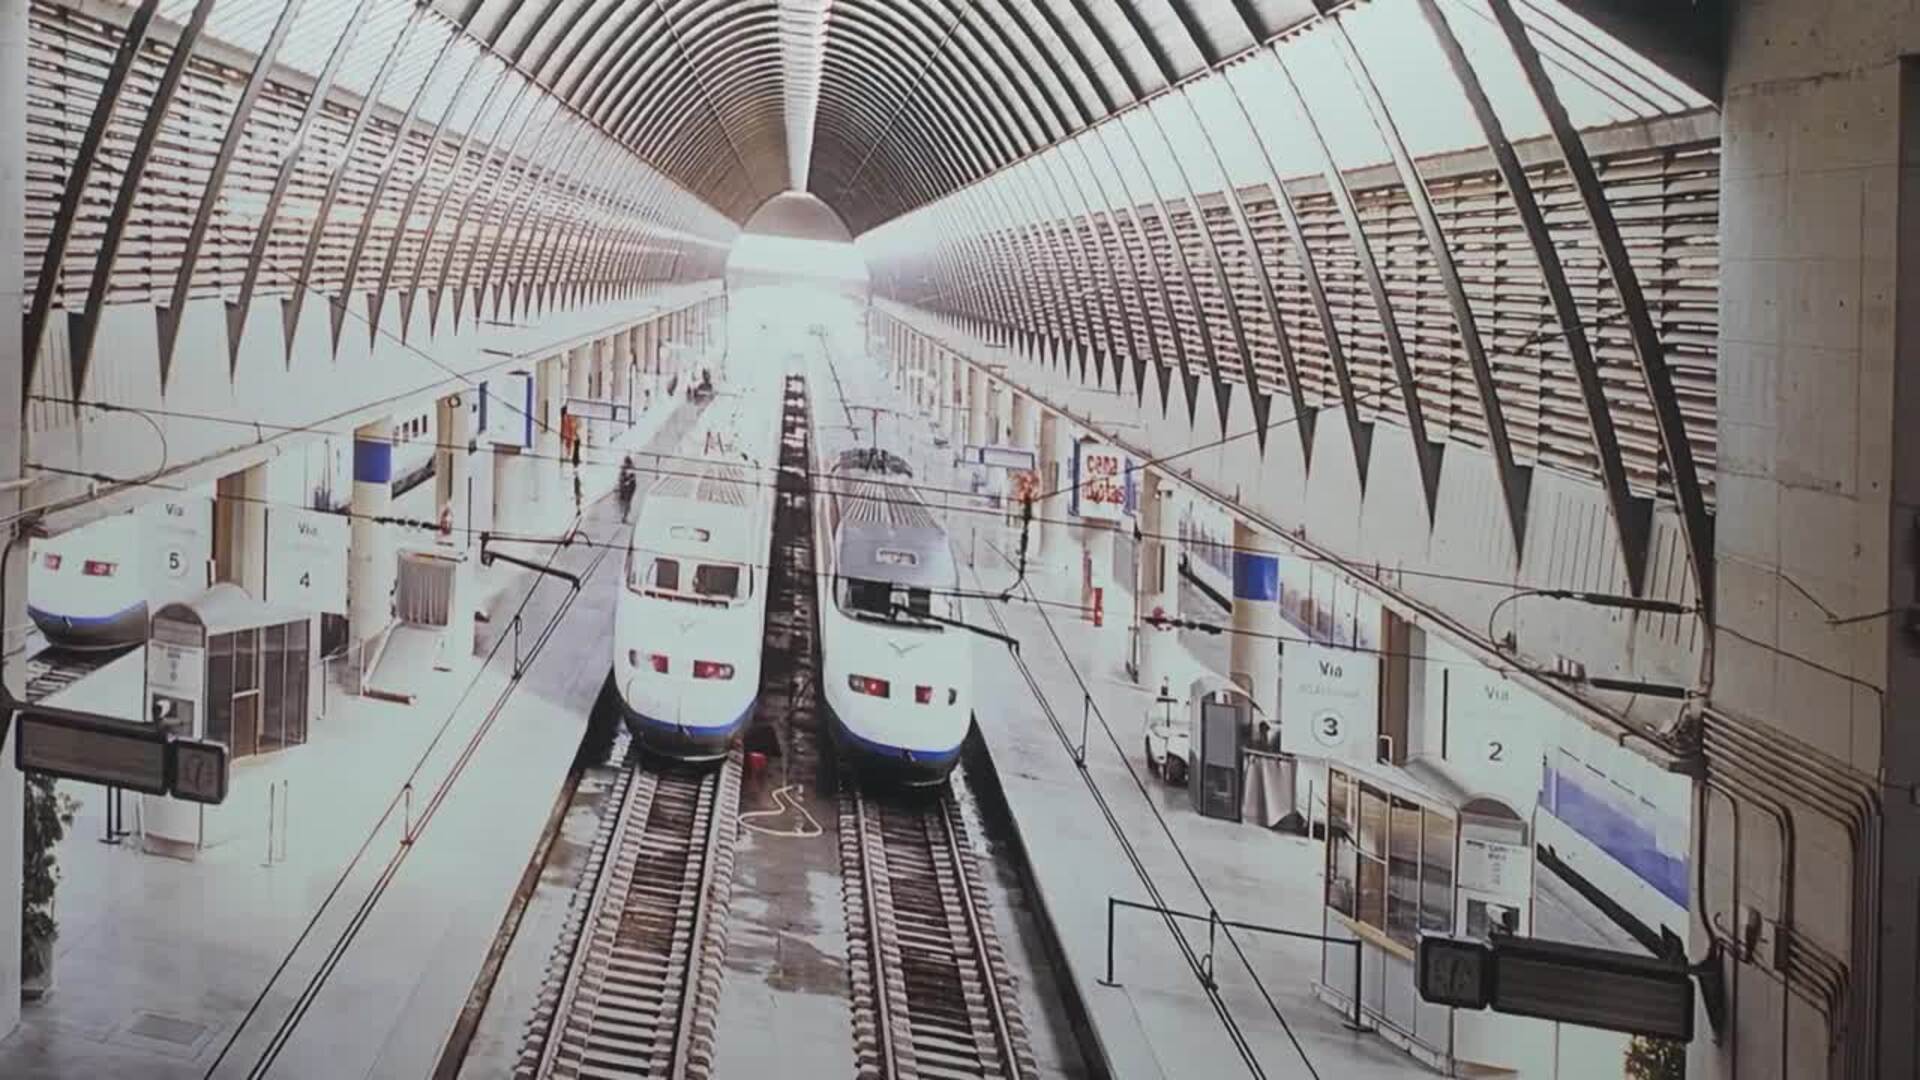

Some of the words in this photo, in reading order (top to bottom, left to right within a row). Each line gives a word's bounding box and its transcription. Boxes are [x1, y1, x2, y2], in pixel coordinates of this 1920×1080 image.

[169, 551, 180, 570] 5
[299, 571, 310, 588] 4
[1323, 717, 1339, 737] 3
[1488, 741, 1503, 761] 2
